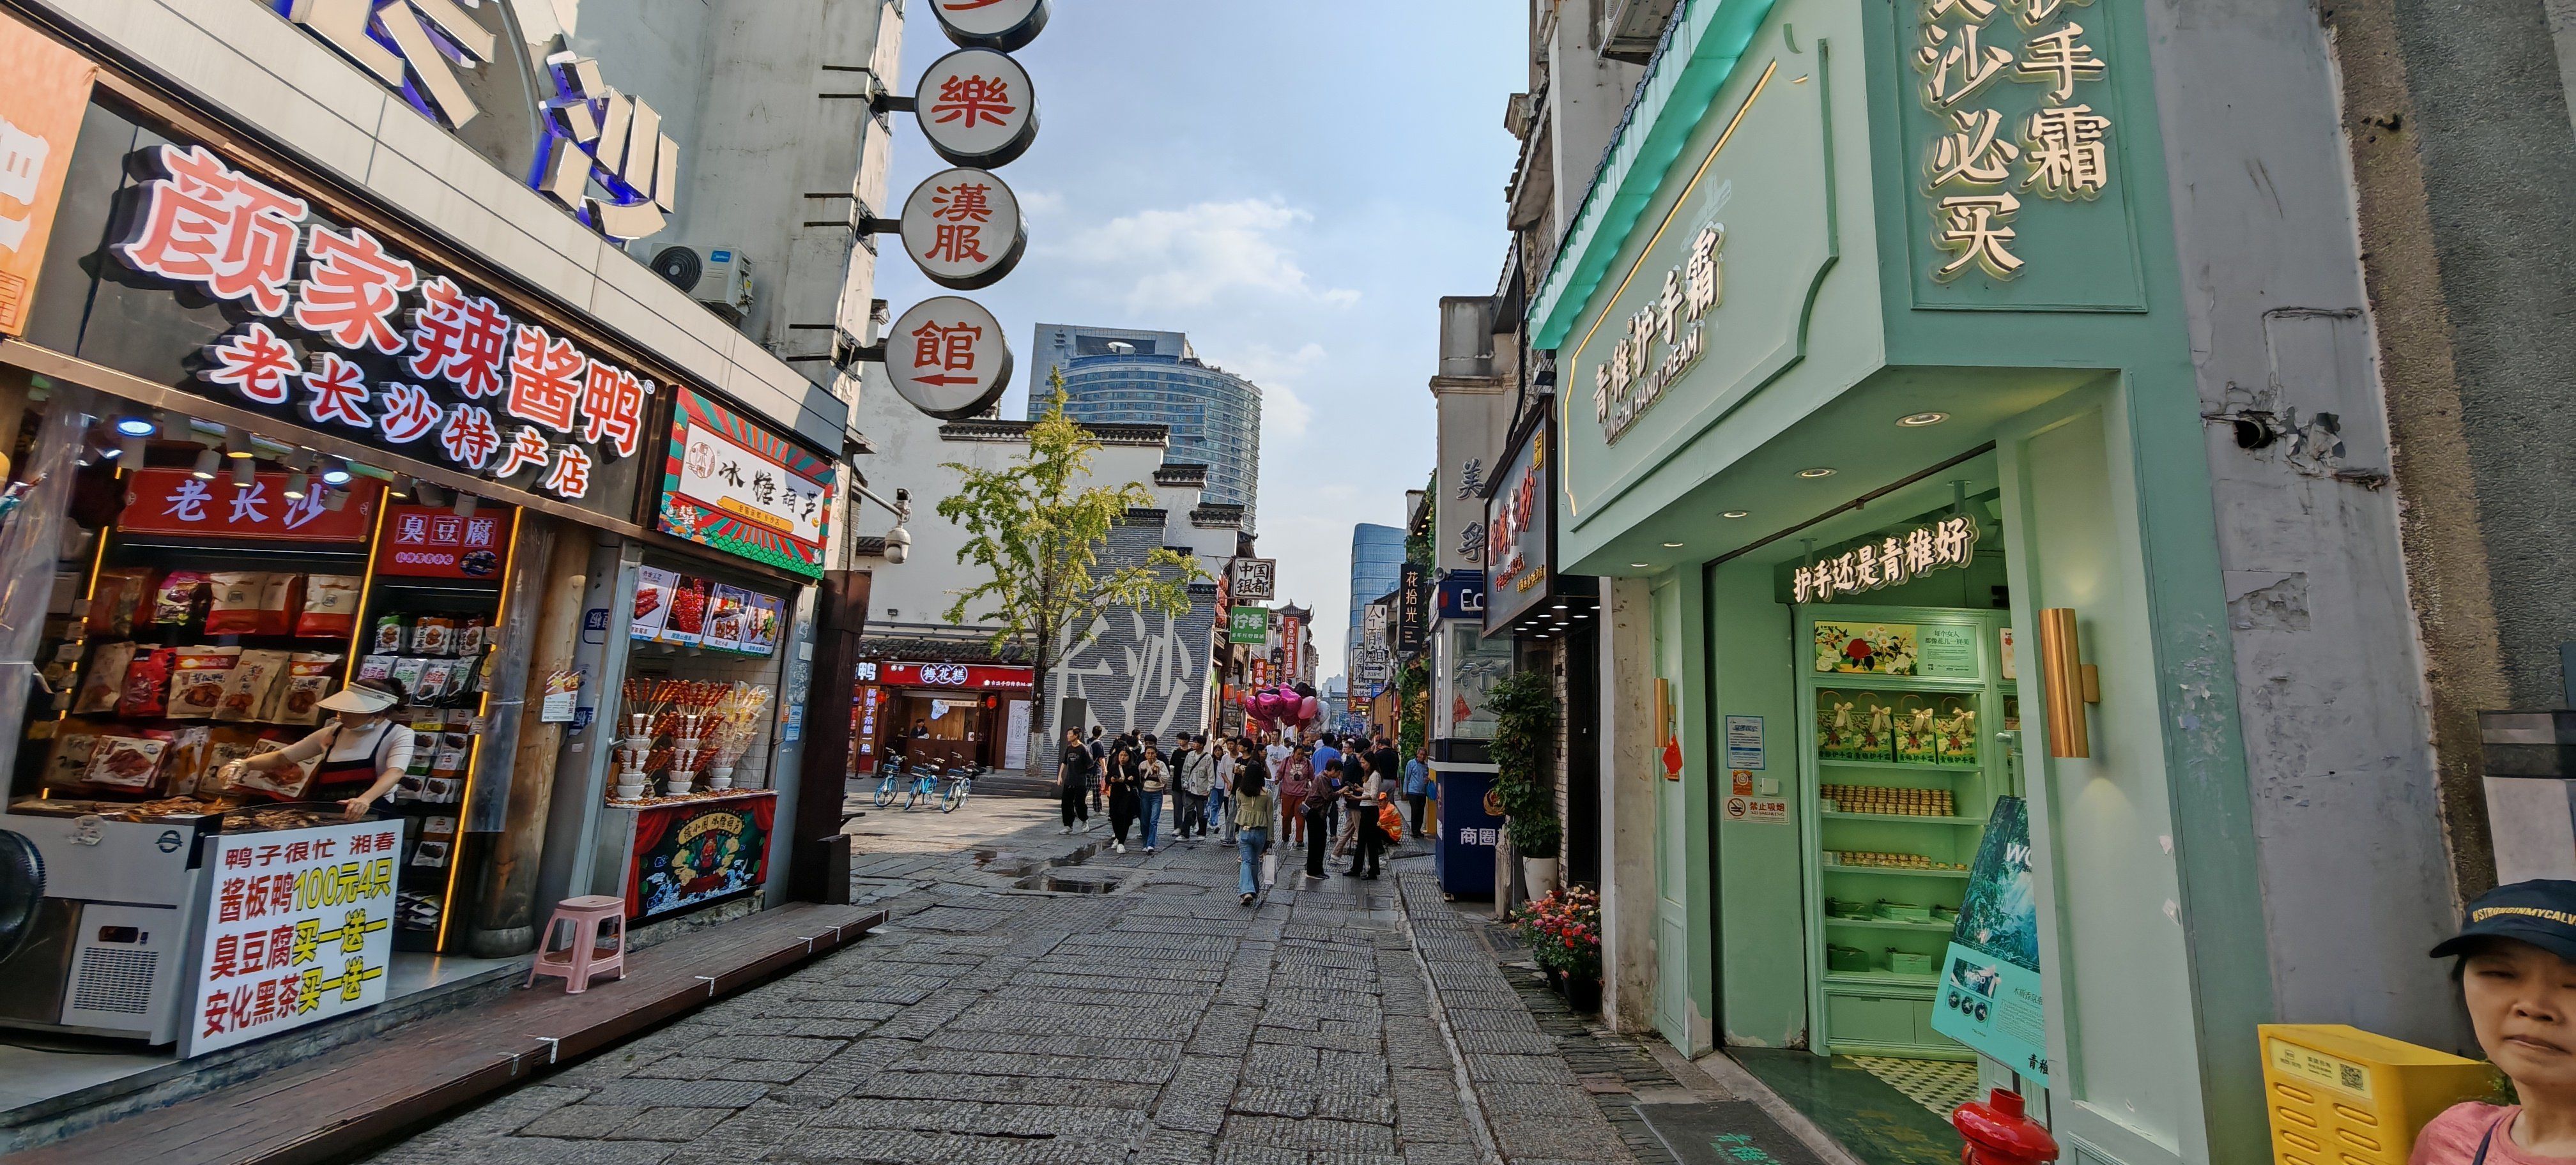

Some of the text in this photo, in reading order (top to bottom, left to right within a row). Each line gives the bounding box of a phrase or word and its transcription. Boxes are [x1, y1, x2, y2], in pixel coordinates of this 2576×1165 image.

[2015, 0, 2112, 193] 手霜
[1917, 0, 2025, 275] 沙必买
[924, 183, 993, 263] 漢服
[125, 144, 644, 458] 颜家辣酱鸭
[1593, 227, 1720, 424] 青稚护手霜
[912, 320, 982, 372] 館
[211, 323, 592, 499] 老长沙特产店
[1604, 325, 1705, 445] QINGZHI HAND CREAM
[162, 480, 328, 530] 老长沙
[718, 460, 819, 522] 冰糖葫芦
[399, 516, 493, 547] 臭豆腐
[1793, 515, 1972, 603] 护手还是青稚好
[1238, 562, 1269, 581] 中国
[1406, 571, 1418, 623] 花拾光
[1233, 613, 1264, 630] 柠季
[924, 665, 966, 681] 梅花糕
[1048, 607, 1192, 749] 长沙
[1460, 826, 1503, 846] 商圈
[1749, 801, 1785, 812] 禁止吸烟
[225, 832, 396, 869] 鸭子很忙 湘春
[210, 908, 388, 981] 臭豆腐买一送一
[202, 956, 383, 1039] 安化黑茶买一送一
